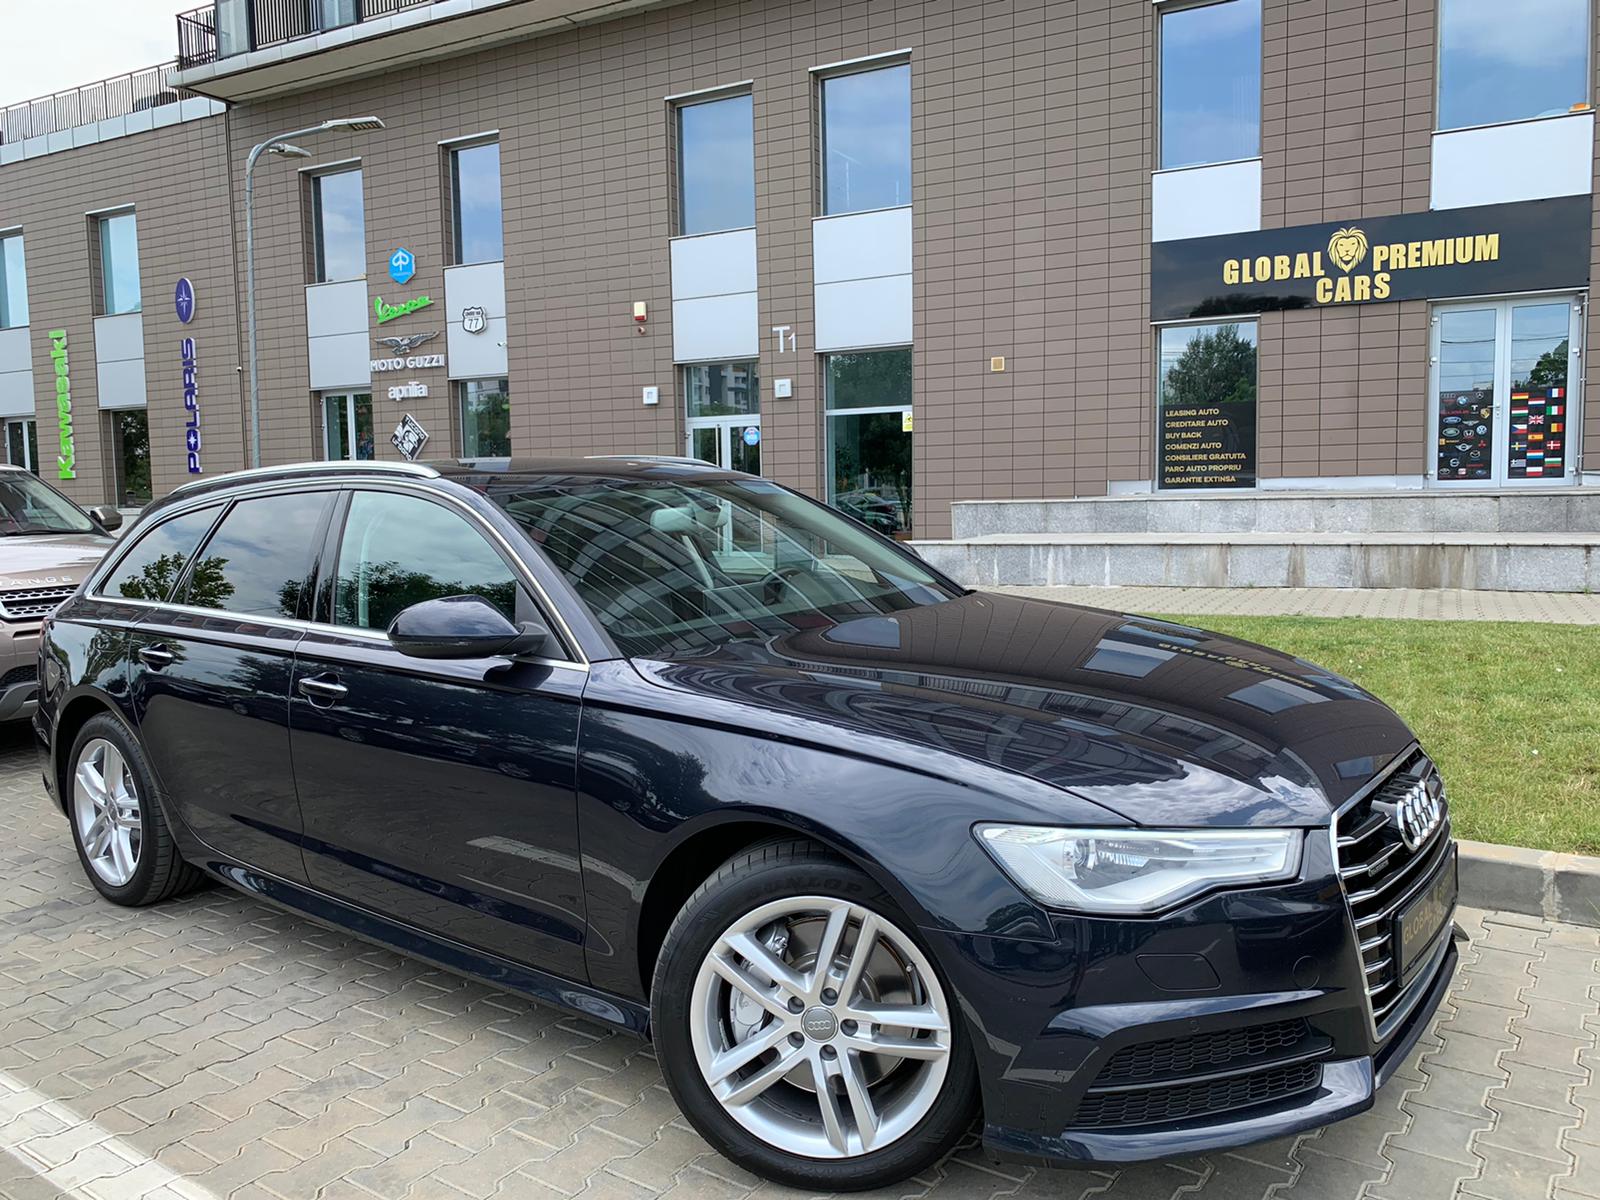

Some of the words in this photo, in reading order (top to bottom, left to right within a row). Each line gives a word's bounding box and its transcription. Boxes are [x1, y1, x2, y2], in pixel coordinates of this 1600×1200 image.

[1223, 251, 1325, 285] GLOBAL
[1372, 233, 1500, 272] PREMIUM
[1315, 272, 1391, 303] CARS
[374, 295, 434, 325] Vespa
[370, 358, 405, 372] MOTO
[406, 354, 445, 369] GUZZI
[48, 329, 76, 480] Kawasaki
[181, 337, 203, 474] POLARIS
[1165, 409, 1197, 417] LEASING
[1198, 408, 1220, 416] AUTO
[1165, 420, 1206, 428] CREDITARE
[1181, 431, 1202, 439] BACK
[1165, 454, 1208, 462] CONSILIERE
[1165, 465, 1185, 473] PARC
[1186, 464, 1207, 472] AUTO
[1203, 475, 1236, 483] EXTINSA
[0, 576, 73, 587] ANGE
